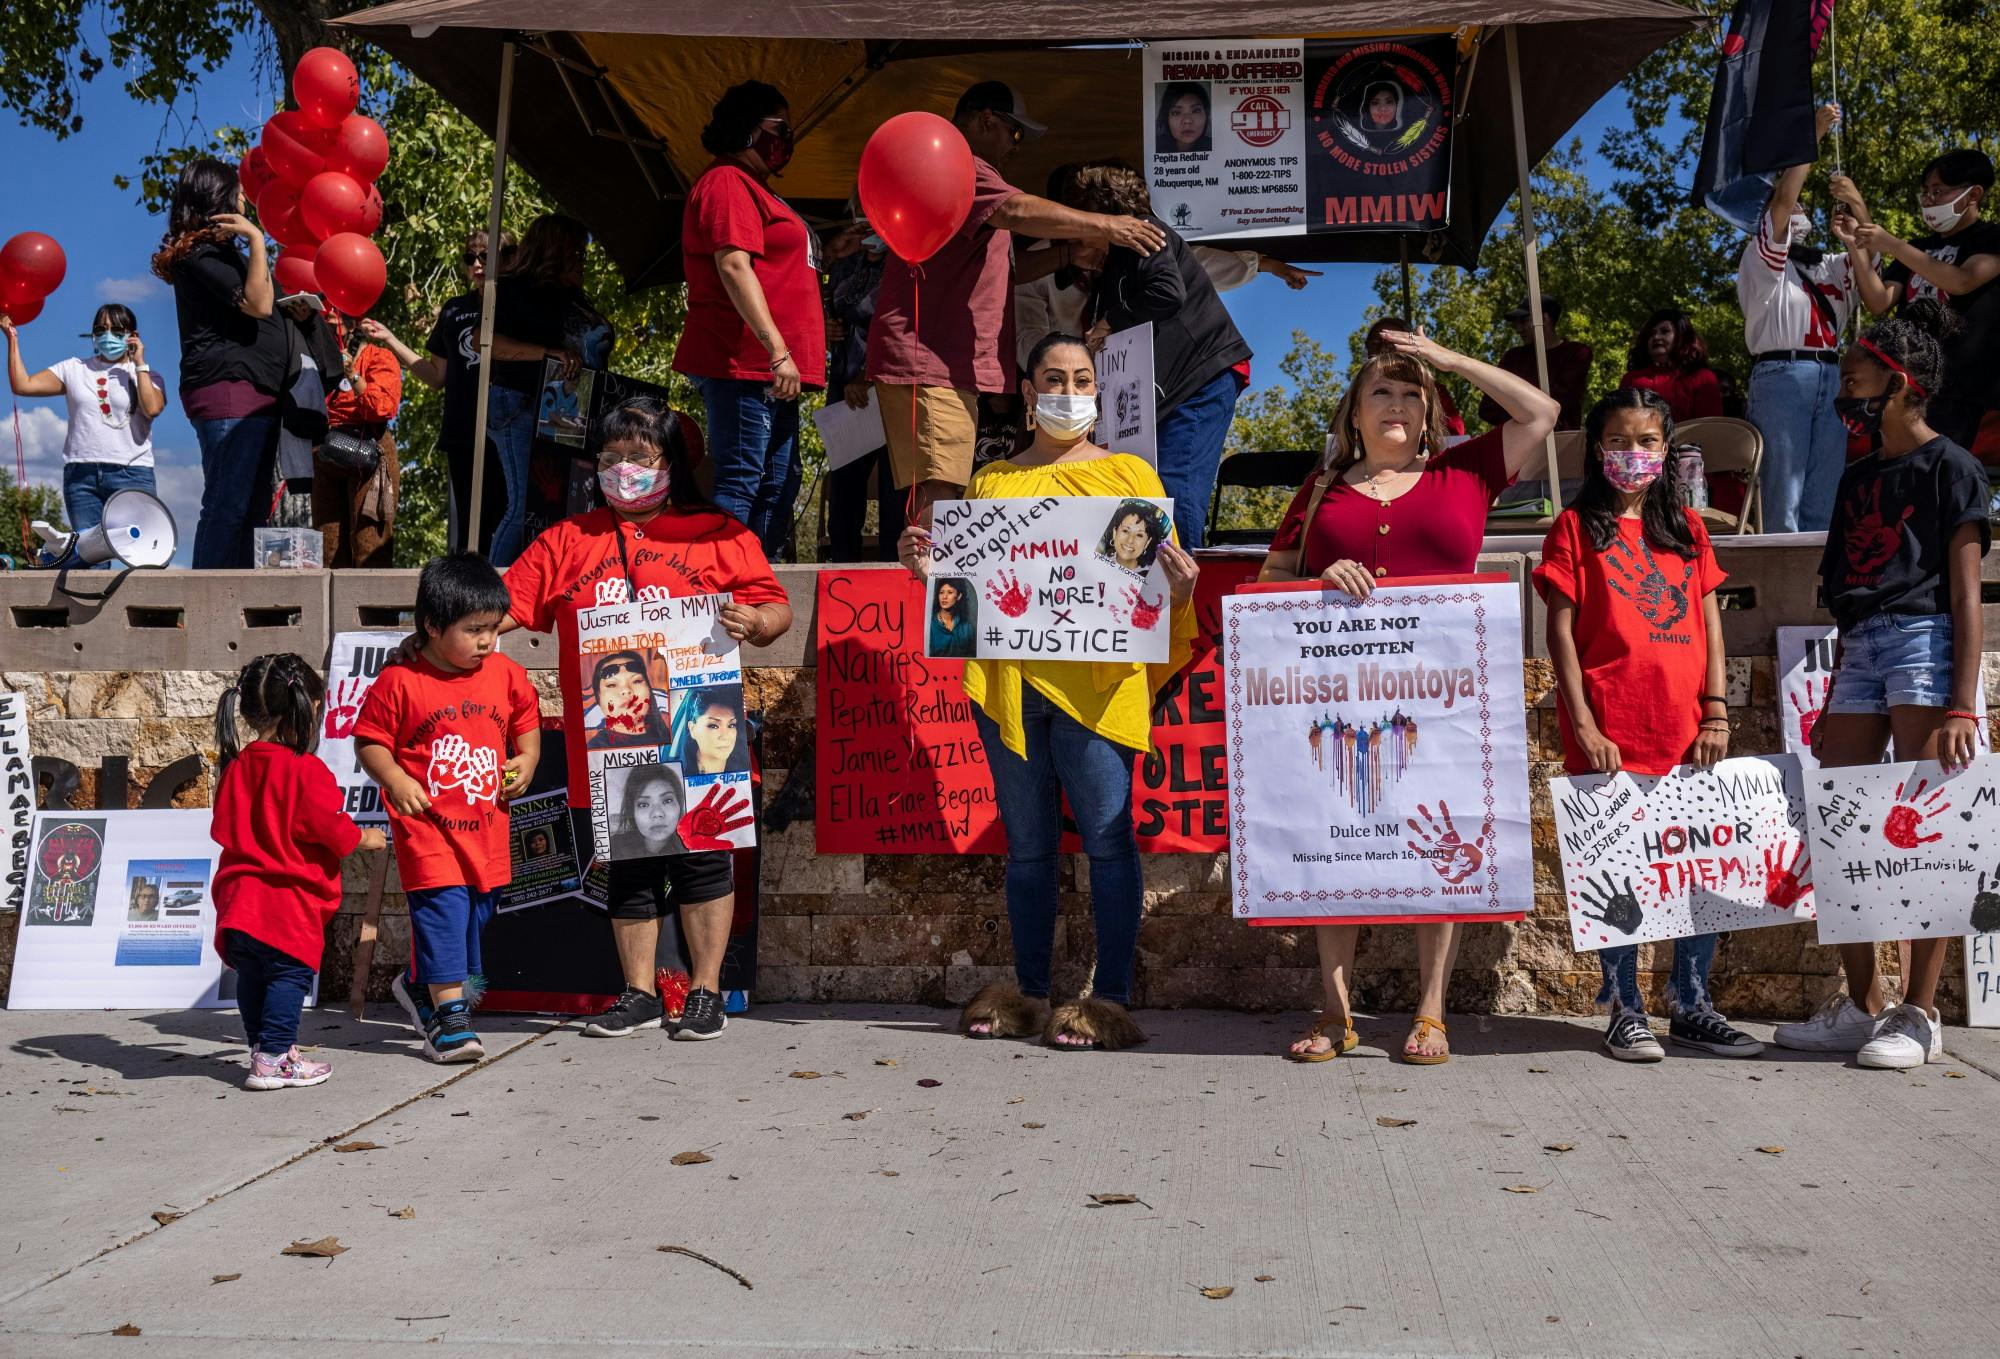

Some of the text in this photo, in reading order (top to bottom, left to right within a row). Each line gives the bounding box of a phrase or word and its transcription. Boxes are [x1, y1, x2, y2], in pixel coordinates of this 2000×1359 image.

[1162, 48, 1300, 60] MISSING & ENDANGERED
[1162, 62, 1302, 80] REWARD OFFERED
[1352, 42, 1391, 58] MISSING
[1392, 43, 1438, 75] INDIGENOUS
[1434, 73, 1452, 105] WOMEN
[1230, 86, 1290, 95] IF YOU SEE HER
[1250, 102, 1270, 110] CALL
[1154, 152, 1209, 164] Pepita Redhair
[1224, 157, 1298, 168] ANONYMOUS TIPS
[1317, 126, 1448, 176] NO MORE STOLEN SISTERS
[1154, 165, 1200, 176] 28 years old
[1232, 170, 1291, 180] 1-800-222-TIPS
[1154, 178, 1218, 189] Albuquerque, NM
[1228, 184, 1298, 195] NAMUS: MP68550
[1221, 209, 1228, 217] If
[1266, 206, 1304, 214] Something
[1325, 192, 1446, 224] MMIW
[1252, 216, 1290, 224] Something
[933, 505, 1007, 562] are not
[955, 498, 1060, 572] Forgotten
[634, 549, 663, 566] for
[1010, 538, 1078, 562] MMIW
[1049, 565, 1076, 583] NO
[1039, 582, 1105, 608] MORE!
[826, 577, 904, 649] Say
[1293, 616, 1420, 635] YOU ARE NOT
[582, 632, 666, 654] SHAWNA TOYA
[1300, 640, 1415, 659] FORGOTTEN
[1649, 632, 1691, 644] MMIW
[826, 640, 958, 687] Names...
[1246, 660, 1476, 708] Melissa Montoya
[462, 700, 486, 719] for
[830, 689, 898, 734] Pepita
[604, 750, 658, 768] MISSING
[830, 733, 984, 776] Jamie Yazzie
[1137, 744, 1228, 793] OLE
[590, 770, 606, 817] REDHAIR
[1717, 769, 1786, 808] MMIW
[830, 783, 880, 823] Ella
[932, 780, 1001, 824] Begay
[1560, 787, 1600, 826] NO
[1818, 794, 1846, 826] Am
[594, 820, 610, 862] PEPITA
[875, 818, 969, 846] #MMIW
[1330, 824, 1399, 838] Dulce NM
[1564, 820, 1606, 854] More
[1643, 822, 1752, 862] HONOR
[1583, 822, 1630, 866] SISTERS
[1819, 837, 1836, 850] I
[1293, 850, 1445, 864] Missing Since March 16, 2001
[1650, 856, 1750, 901] THEM!
[1442, 886, 1482, 896] MMIW
